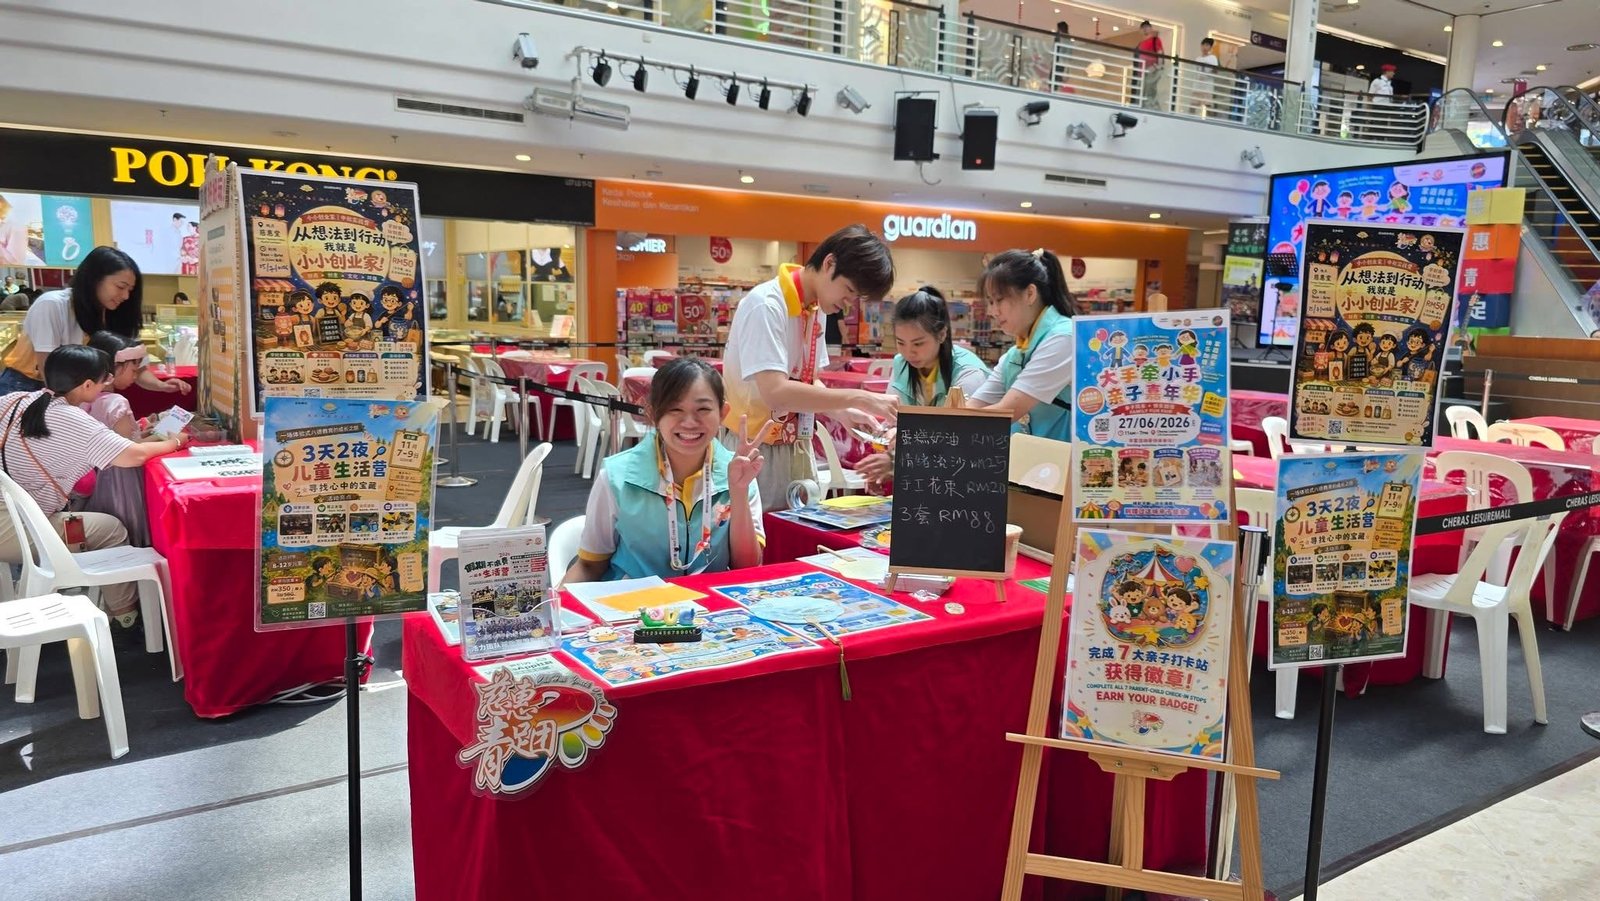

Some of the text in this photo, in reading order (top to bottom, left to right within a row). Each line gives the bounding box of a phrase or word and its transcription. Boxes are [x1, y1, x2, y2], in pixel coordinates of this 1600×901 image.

[292, 225, 386, 247] 从想法到行动
[883, 213, 977, 242] guardian
[324, 243, 358, 253] 我就是
[393, 255, 414, 268] RM50
[1341, 270, 1424, 290] 从想法到行动
[1367, 285, 1397, 296] 我就是
[1425, 301, 1446, 311] RM50
[1100, 364, 1199, 388] 大手牵小手
[1547, 376, 1578, 384] LEISUREMALL
[1107, 383, 1201, 405] 亲子嘉年华
[1119, 417, 1190, 429] 27/06/2026
[303, 442, 369, 463] 3天2夜
[292, 460, 388, 482] 儿童生活营
[308, 481, 378, 493] 寻找心中的宝藏
[1306, 496, 1361, 517] 3天2夜
[1565, 495, 1589, 509] CHERAS
[900, 503, 931, 525] 3套
[1298, 512, 1375, 536] 儿童生活营
[1442, 508, 1512, 530] CHERAS LEISUREMALL
[1310, 532, 1366, 544] 寻找心中的宝藏
[1096, 691, 1198, 713] EARN YOUR BADGE!
[1129, 685, 1164, 695] PARENT-CHILD
[1165, 689, 1189, 699] CHECK-IN
[1190, 695, 1207, 704] STOPS
